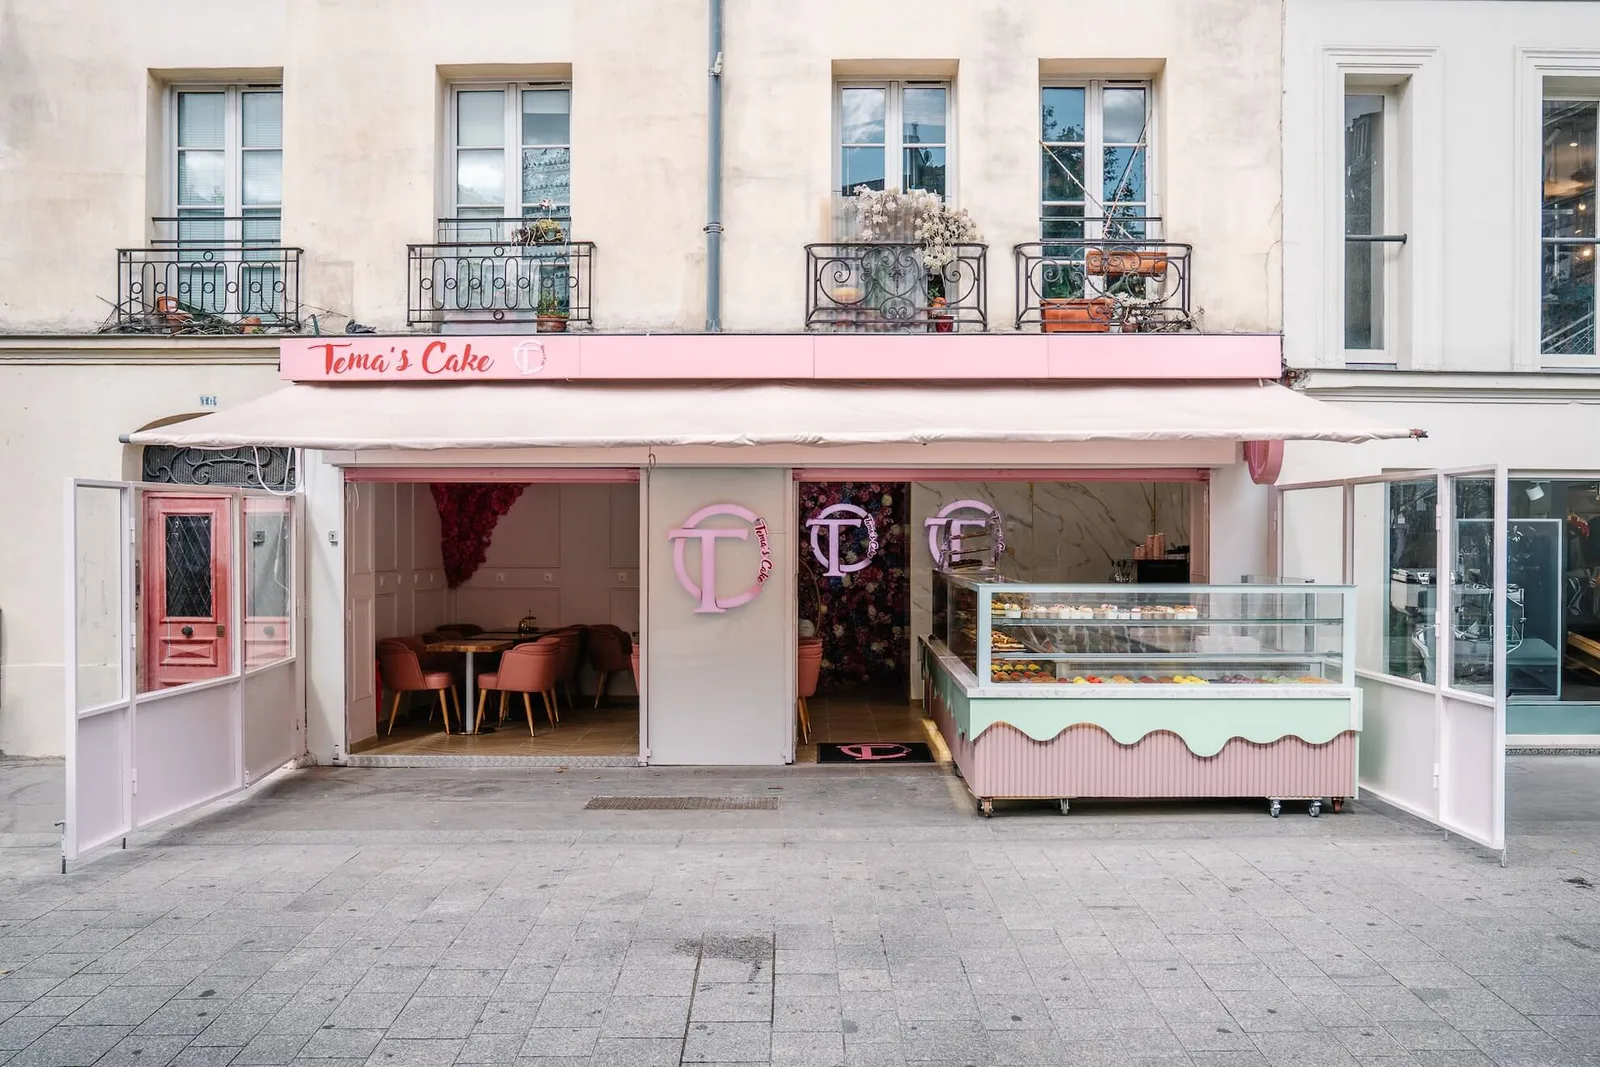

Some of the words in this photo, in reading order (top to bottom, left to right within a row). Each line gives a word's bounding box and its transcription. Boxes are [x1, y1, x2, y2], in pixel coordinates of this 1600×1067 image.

[307, 343, 412, 375] Tema's
[421, 340, 495, 374] Cake
[754, 517, 771, 557] Tema's
[756, 558, 774, 585] Cake
